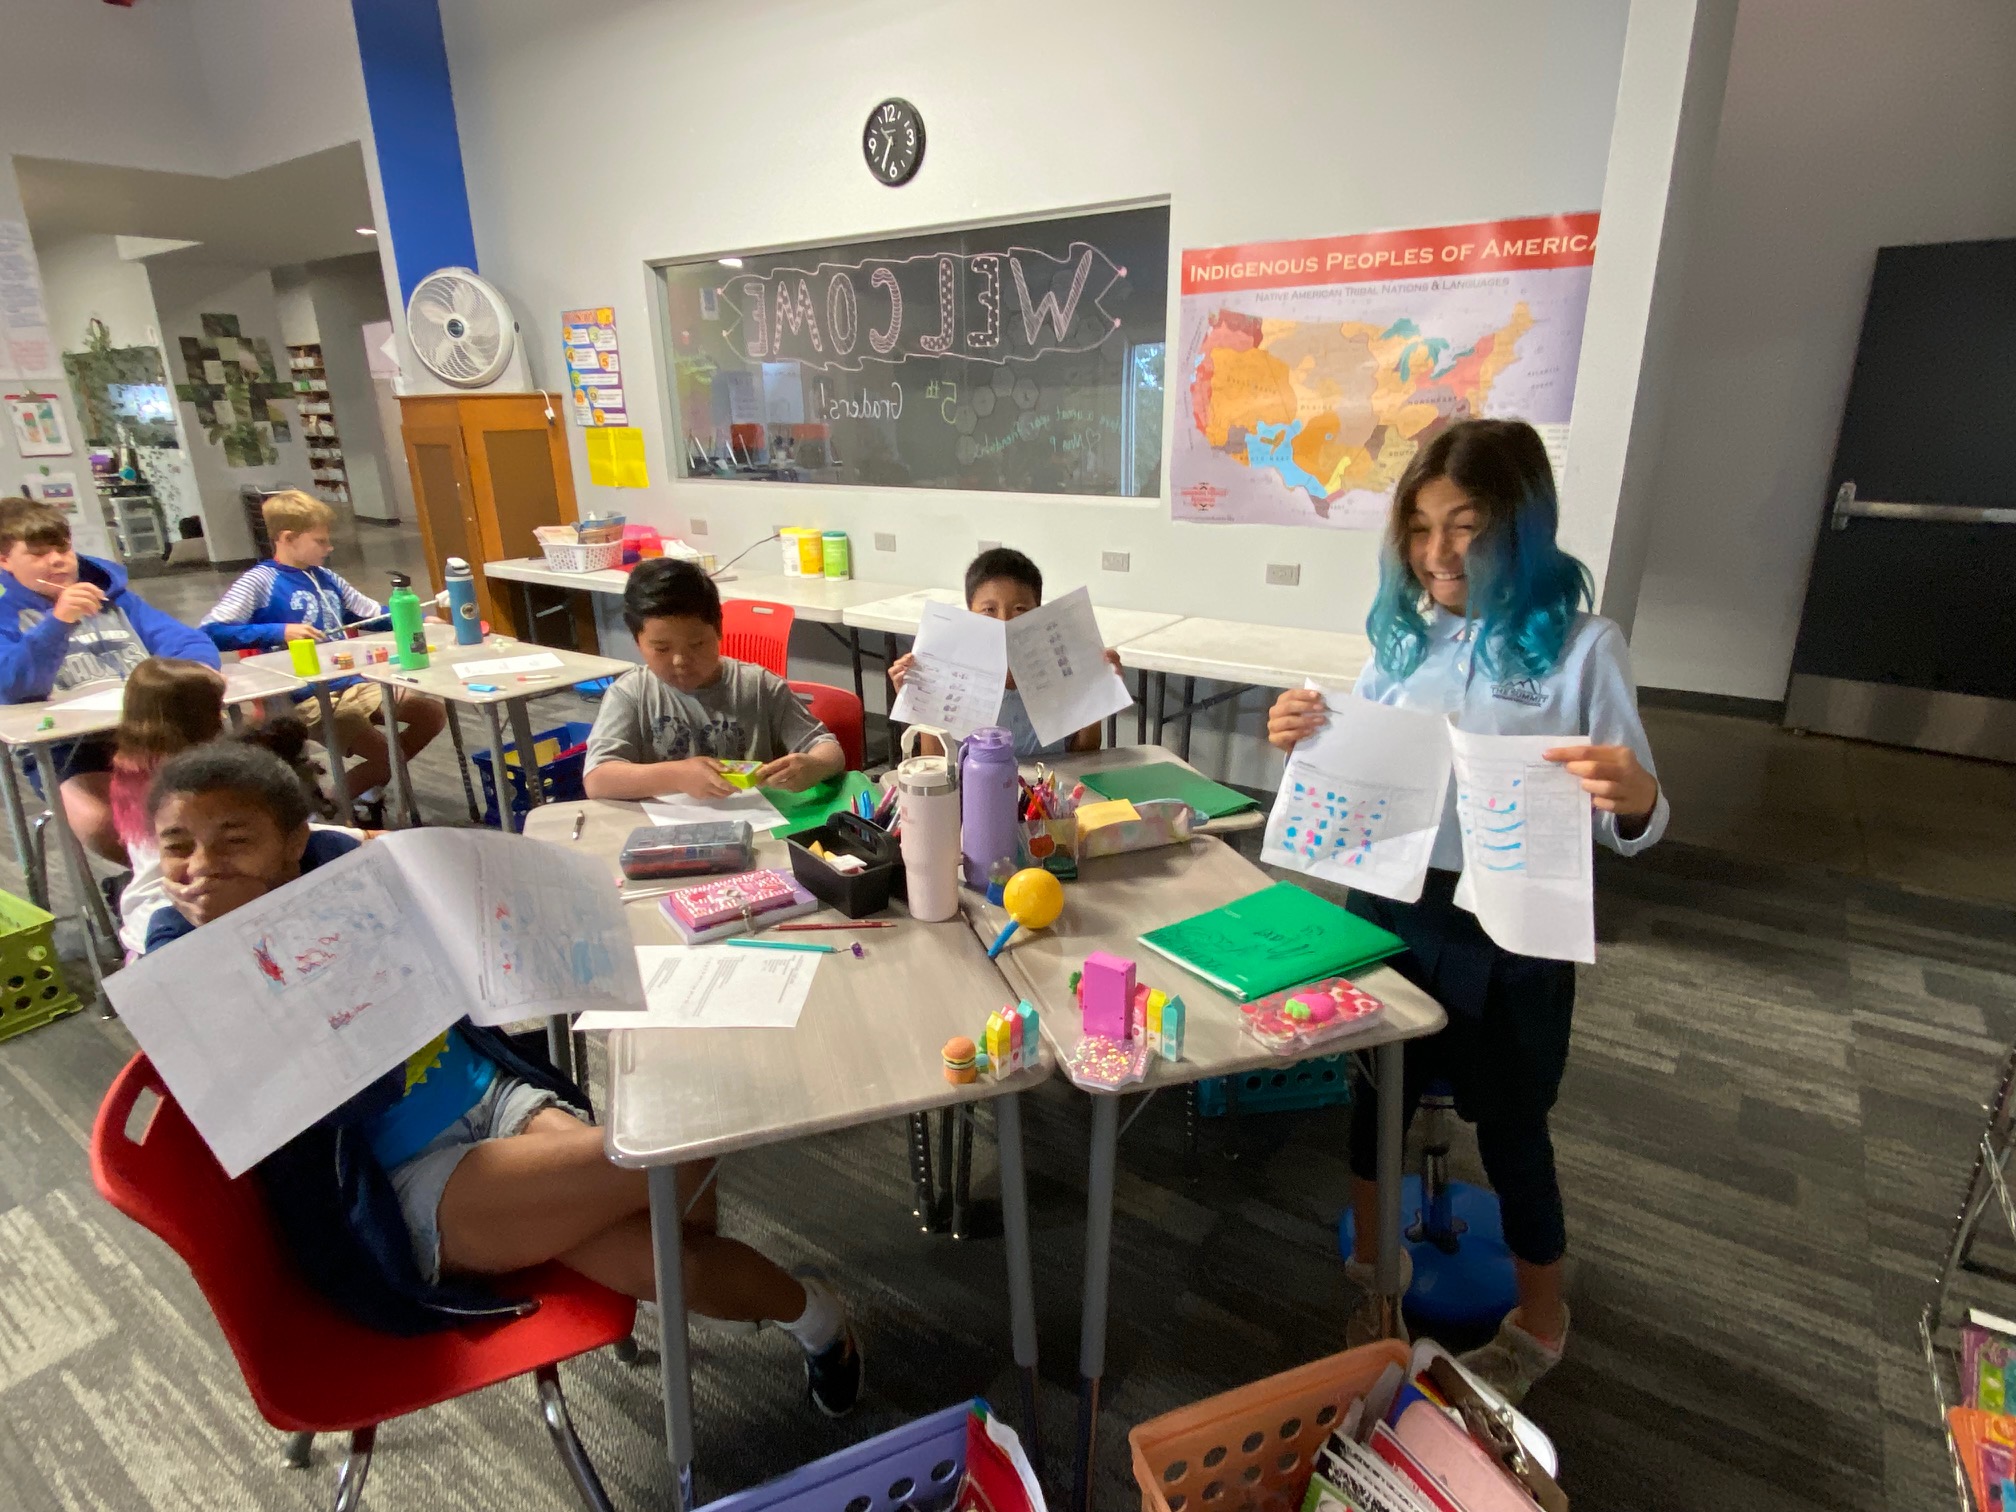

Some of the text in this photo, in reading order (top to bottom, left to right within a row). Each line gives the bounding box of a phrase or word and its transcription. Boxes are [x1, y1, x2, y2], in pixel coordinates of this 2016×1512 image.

[883, 104, 896, 123] 12
[868, 137, 877, 156] 9
[906, 128, 915, 146] 3
[889, 161, 898, 178] 6
[1190, 257, 1319, 282] INDIGENOUS
[1326, 247, 1434, 271] PEOPLES
[1441, 243, 1475, 262] OF
[1255, 291, 1289, 302] NATIVE
[1291, 288, 1342, 301] AMERICAN
[1345, 285, 1378, 297] TRIBAL
[1382, 281, 1429, 294] NATIONS
[1442, 277, 1510, 290] LANGUAGES
